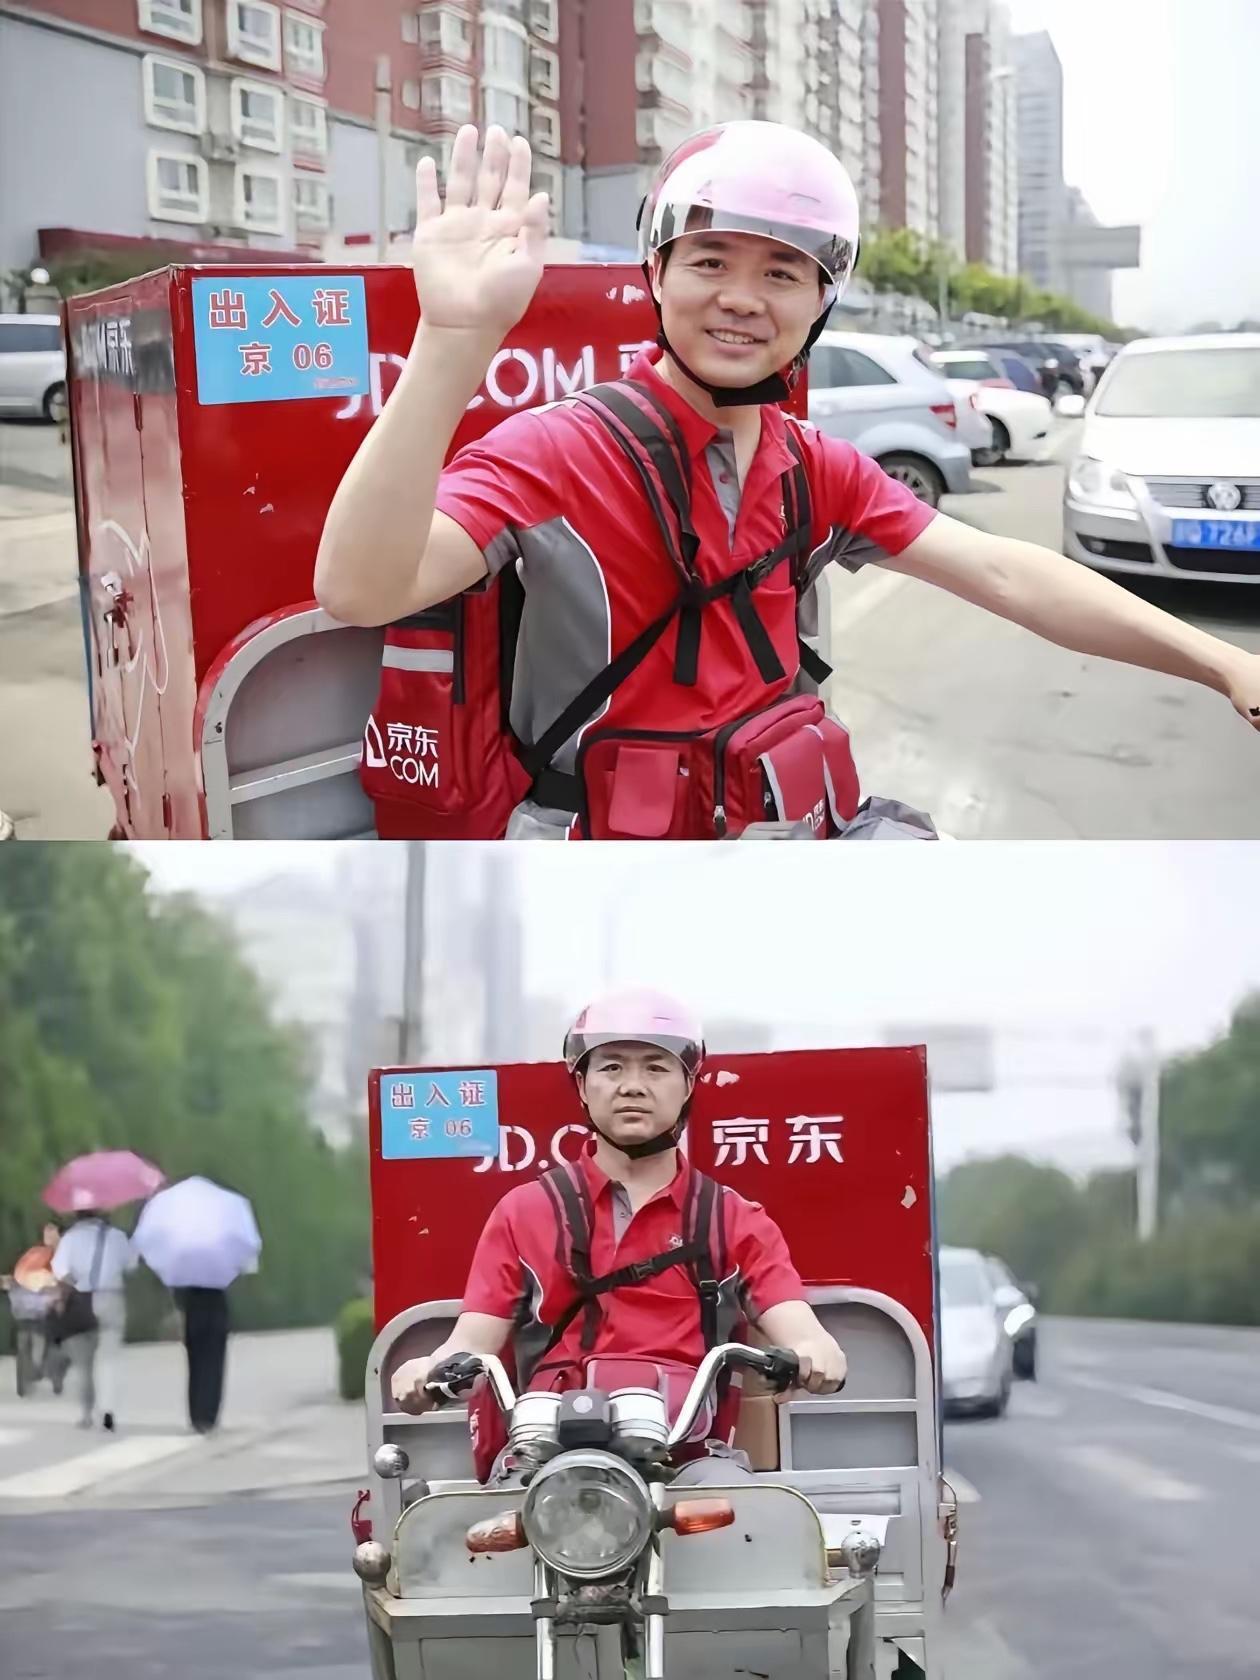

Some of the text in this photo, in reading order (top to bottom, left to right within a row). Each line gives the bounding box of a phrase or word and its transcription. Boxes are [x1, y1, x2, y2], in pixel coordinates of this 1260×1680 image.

[209, 288, 352, 330] 出入证
[238, 341, 333, 376] 京 06
[387, 722, 439, 759] 京东
[390, 755, 439, 789] COM
[391, 1080, 486, 1109] 出入证
[408, 1116, 473, 1140] 京 06
[712, 1115, 844, 1167] 京东
